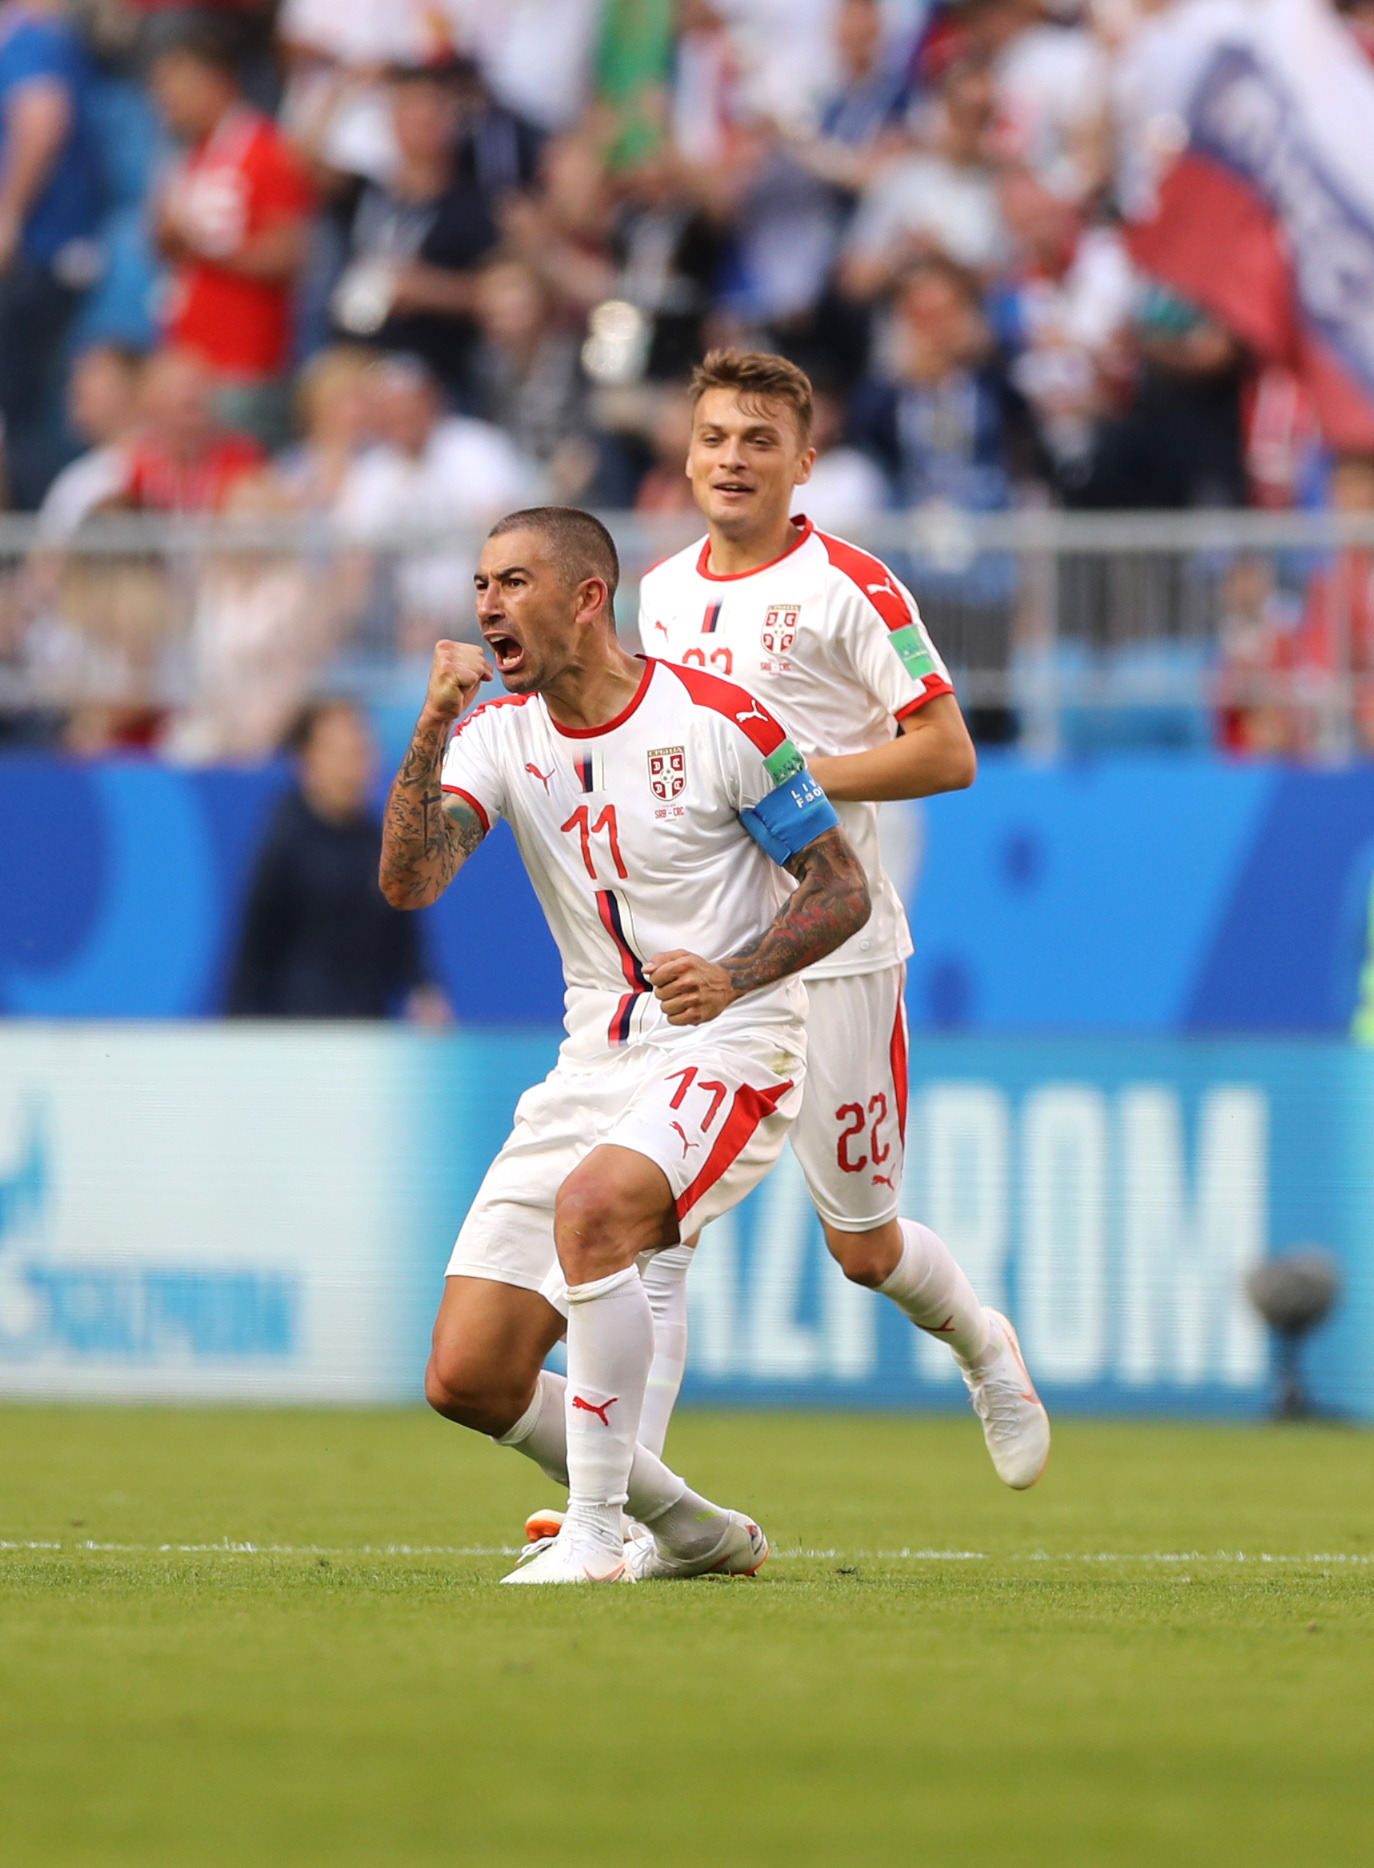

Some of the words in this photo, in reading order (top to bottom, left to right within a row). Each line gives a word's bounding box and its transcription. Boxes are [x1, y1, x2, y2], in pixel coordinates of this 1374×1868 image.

[560, 804, 628, 880] 11
[664, 1066, 728, 1133] 11
[835, 1091, 890, 1173] 22
